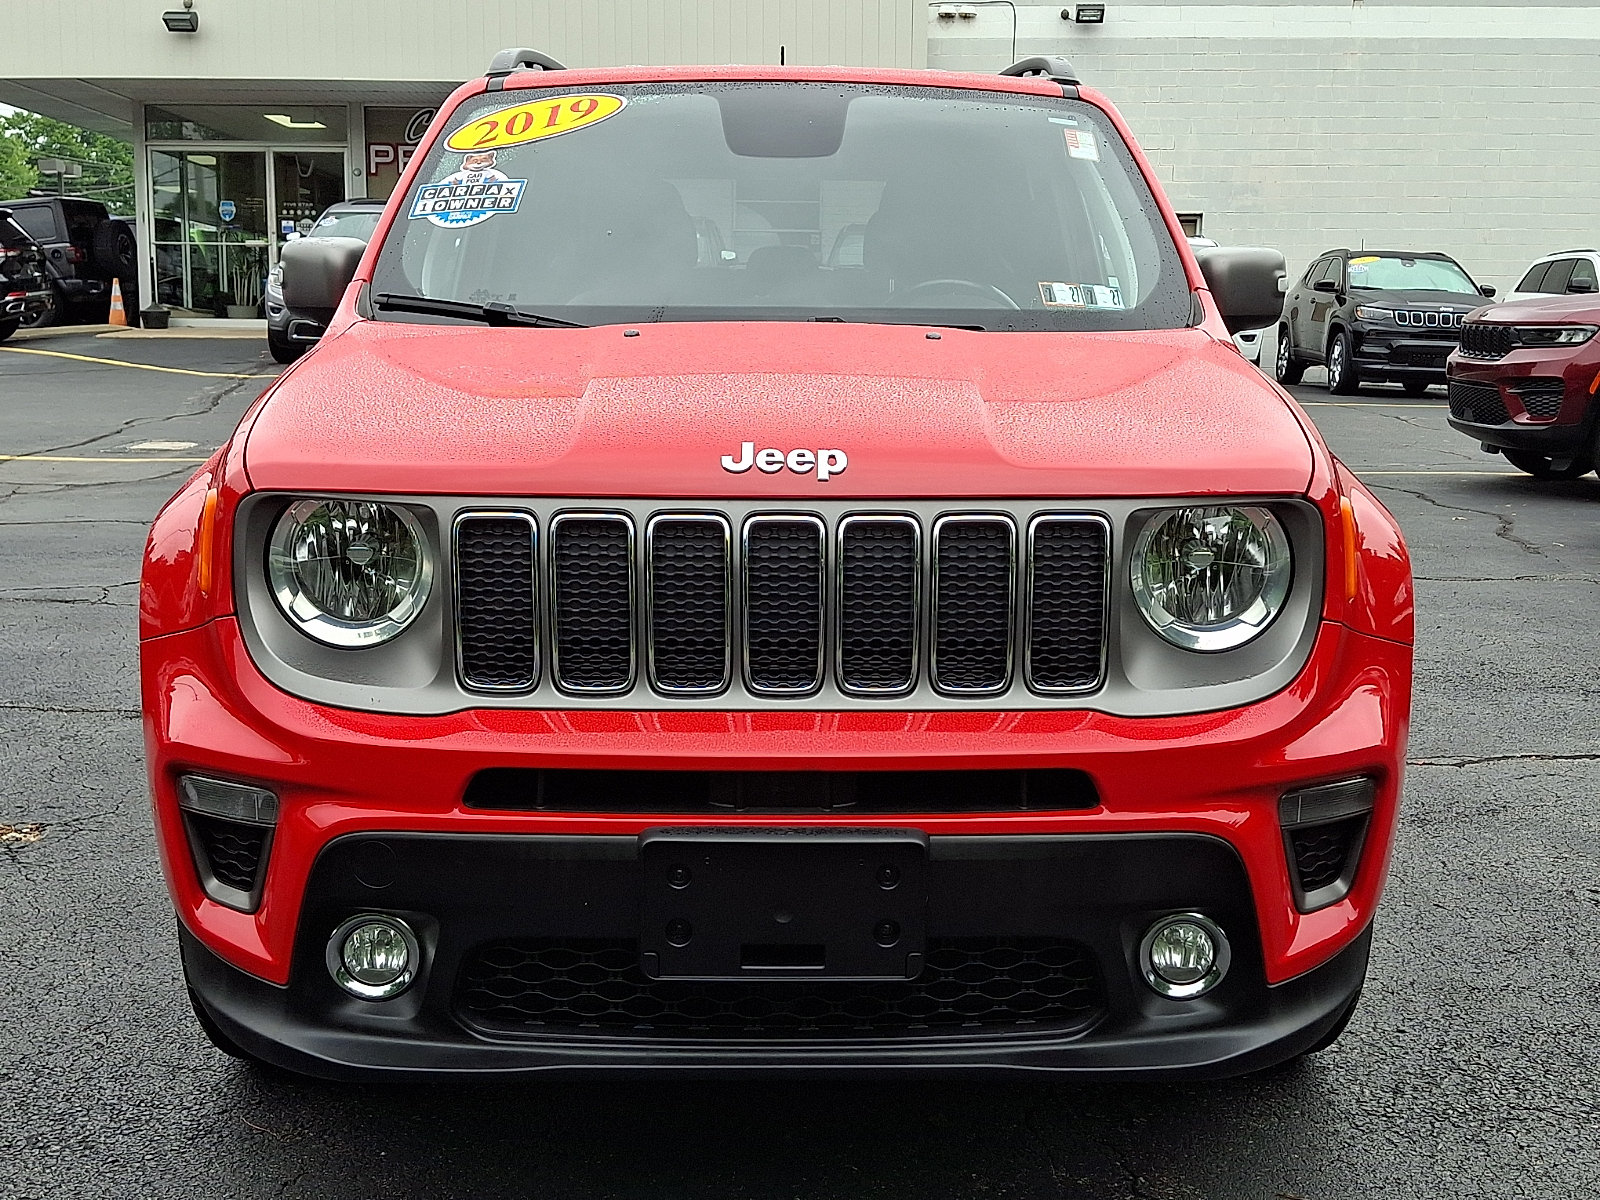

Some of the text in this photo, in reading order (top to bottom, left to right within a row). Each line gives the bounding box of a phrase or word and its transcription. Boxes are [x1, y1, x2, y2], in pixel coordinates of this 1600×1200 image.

[472, 99, 599, 147] 2019
[421, 184, 516, 200] CARFAX
[431, 197, 516, 212] OWNER
[720, 441, 849, 482] Jeep
